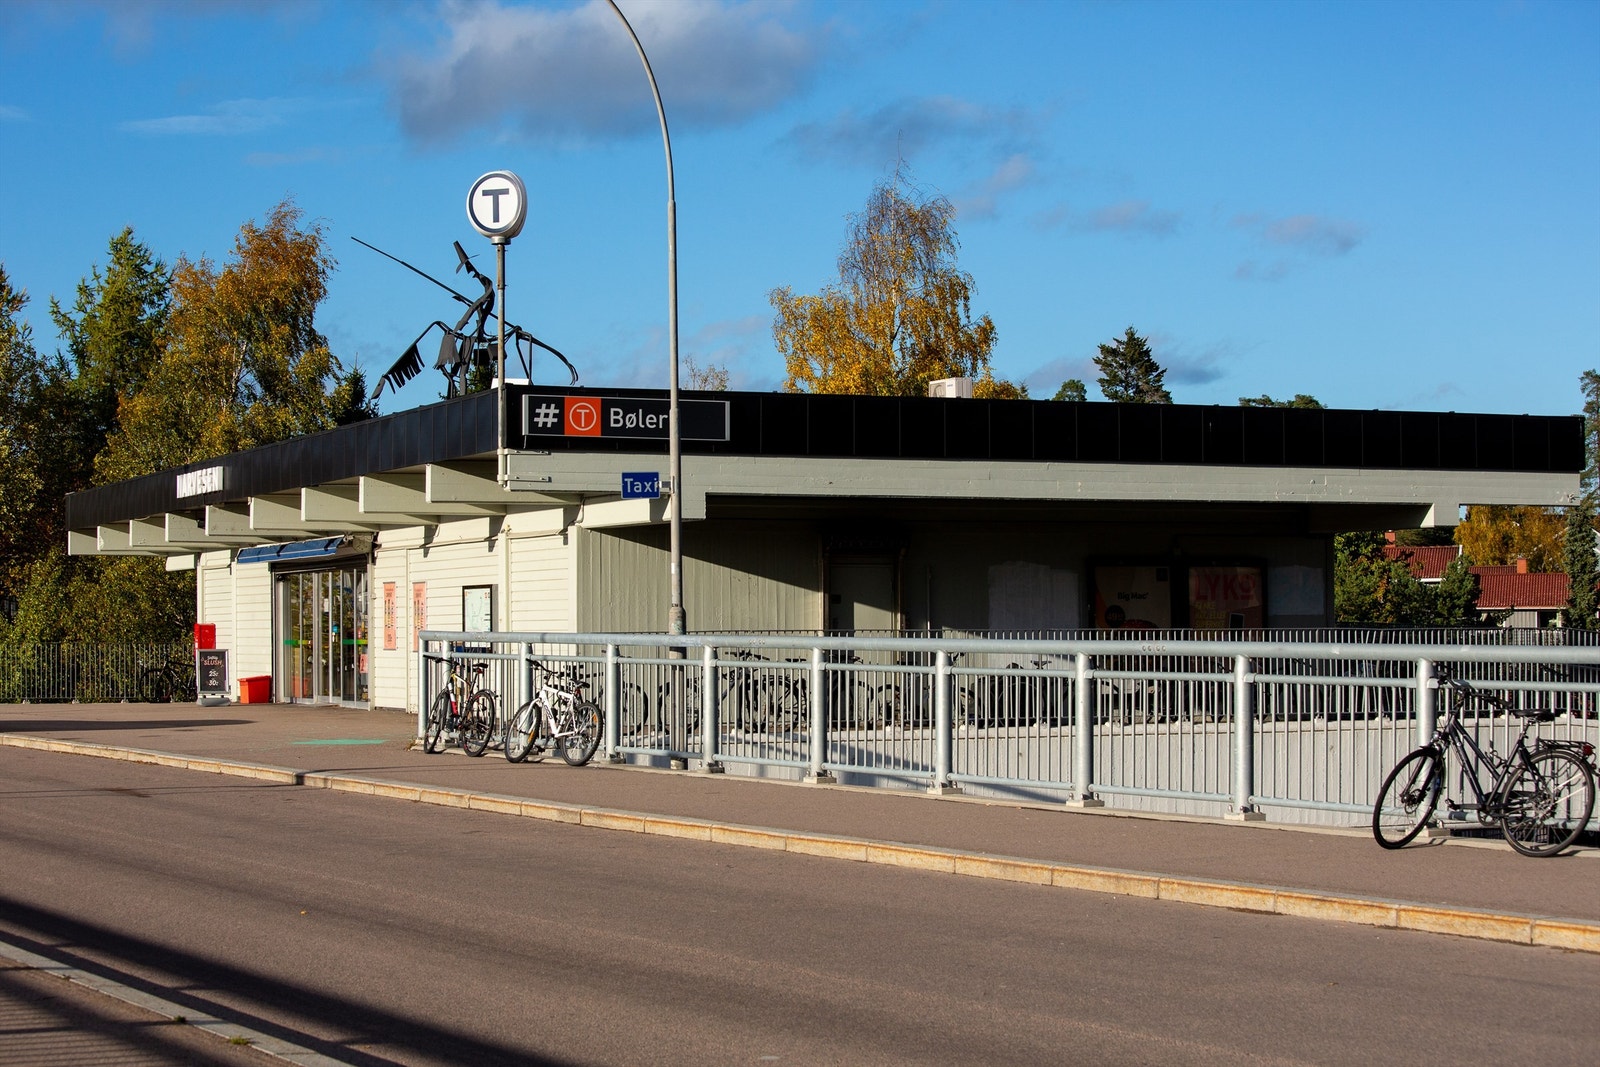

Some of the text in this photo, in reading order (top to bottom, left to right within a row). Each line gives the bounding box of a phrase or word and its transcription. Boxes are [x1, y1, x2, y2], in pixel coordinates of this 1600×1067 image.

[482, 188, 510, 223] T
[609, 407, 669, 429] Bøler
[624, 478, 658, 493] Taxi
